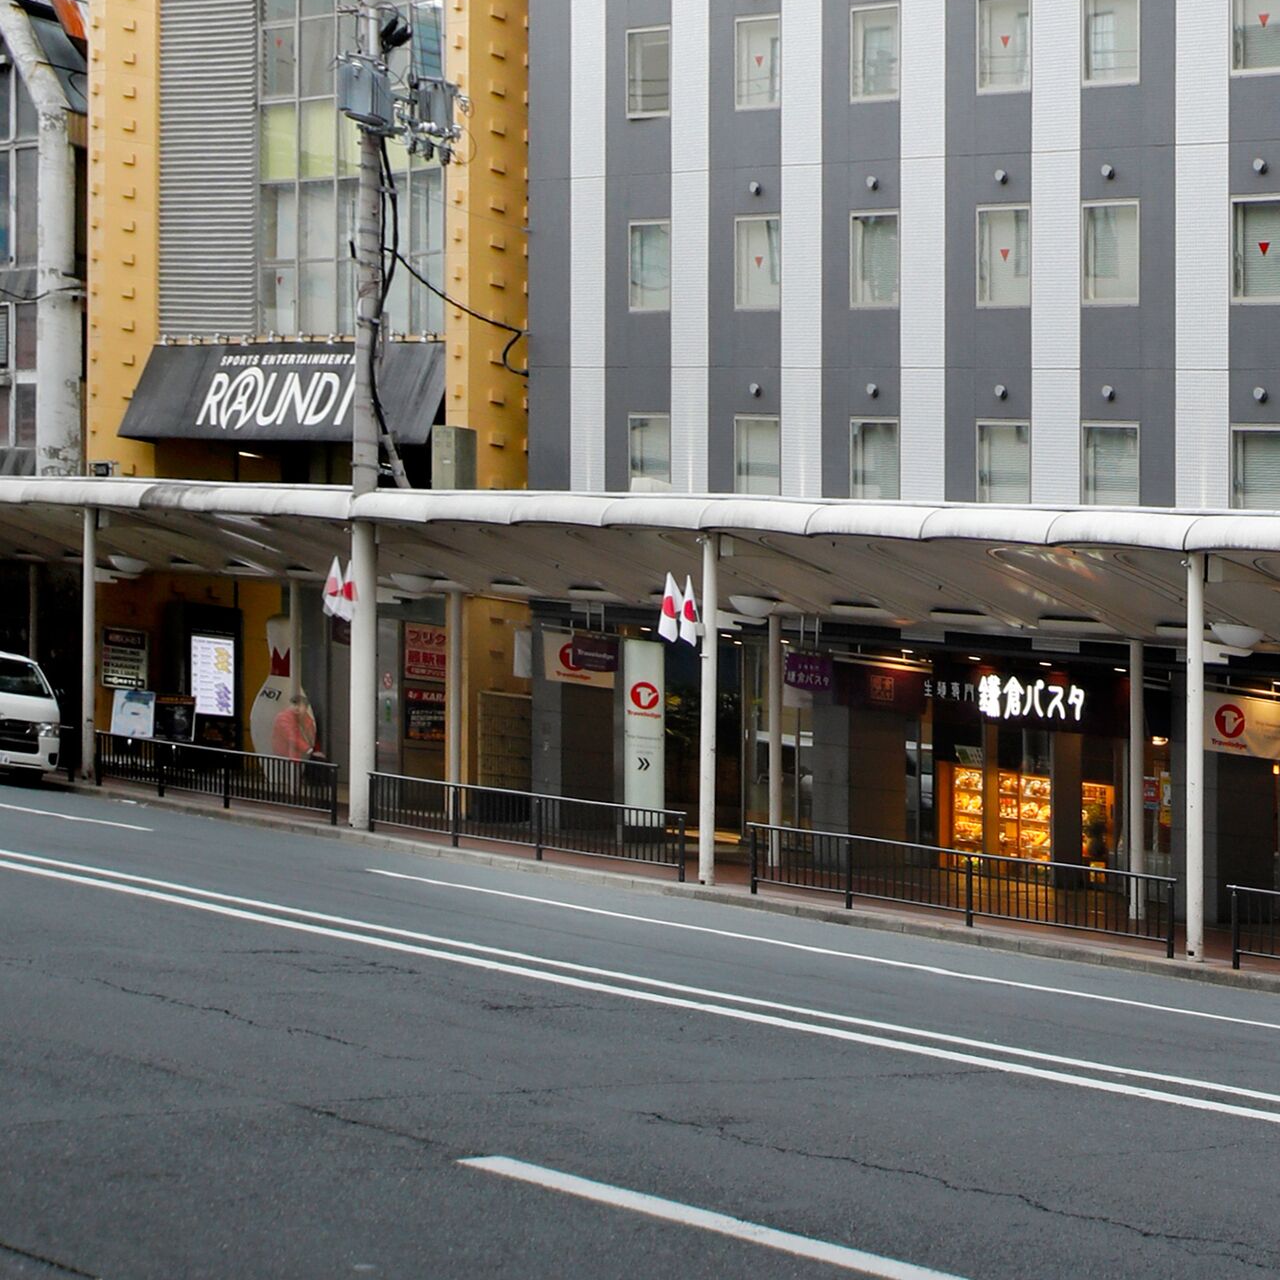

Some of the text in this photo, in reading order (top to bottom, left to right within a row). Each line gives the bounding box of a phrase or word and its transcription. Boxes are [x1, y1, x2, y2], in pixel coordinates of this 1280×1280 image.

[220, 354, 259, 367] SPORTS
[978, 673, 1086, 721] 鎌倉パスタ
